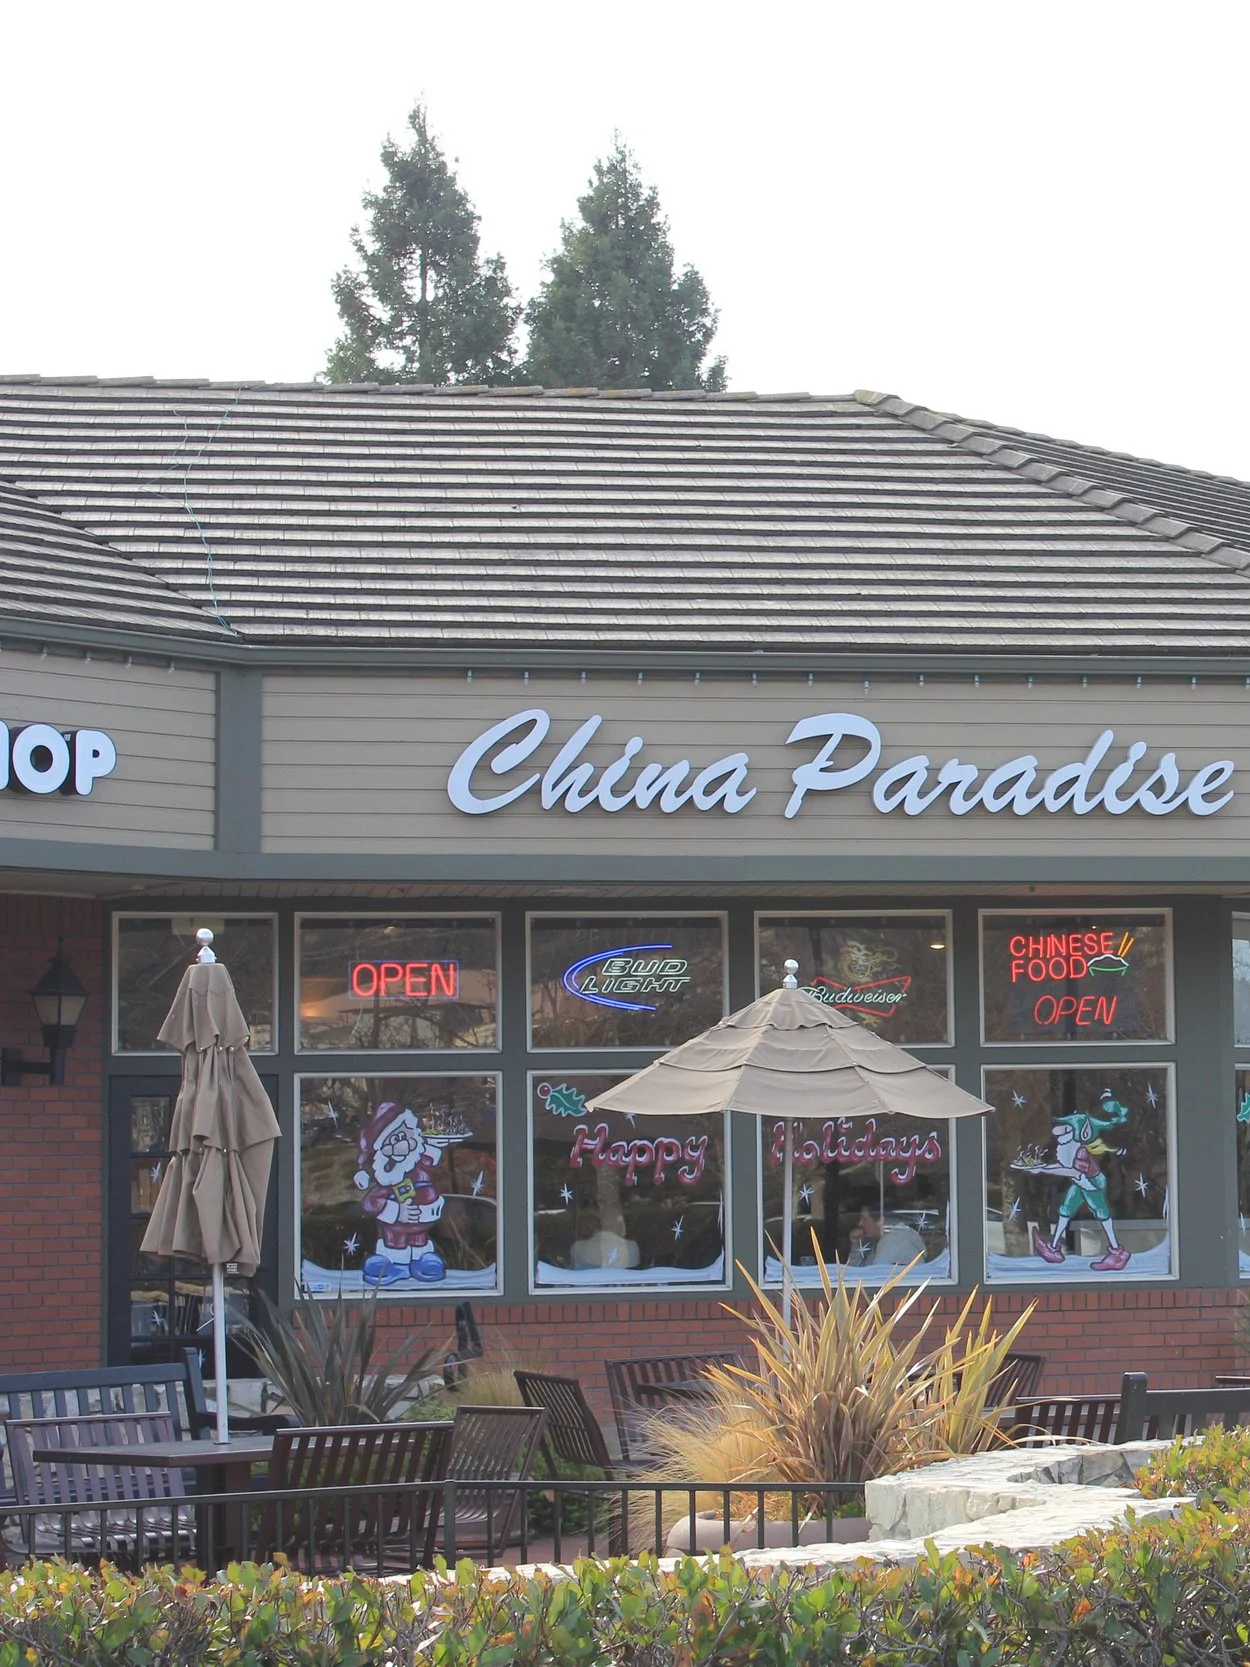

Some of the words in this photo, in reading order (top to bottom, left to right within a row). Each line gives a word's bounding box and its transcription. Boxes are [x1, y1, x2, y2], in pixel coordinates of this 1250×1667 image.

[0, 719, 117, 796] OP
[447, 708, 757, 815] China
[784, 712, 1236, 819] Paradise
[1009, 931, 1115, 959] CHINESE
[351, 962, 457, 998] OPEN
[602, 957, 688, 976] BUD
[1010, 954, 1089, 984] FOOD
[579, 975, 692, 995] LIGHT
[1033, 994, 1118, 1026] OPEN
[569, 1123, 709, 1186] Happy
[770, 1116, 942, 1186] Holidays
